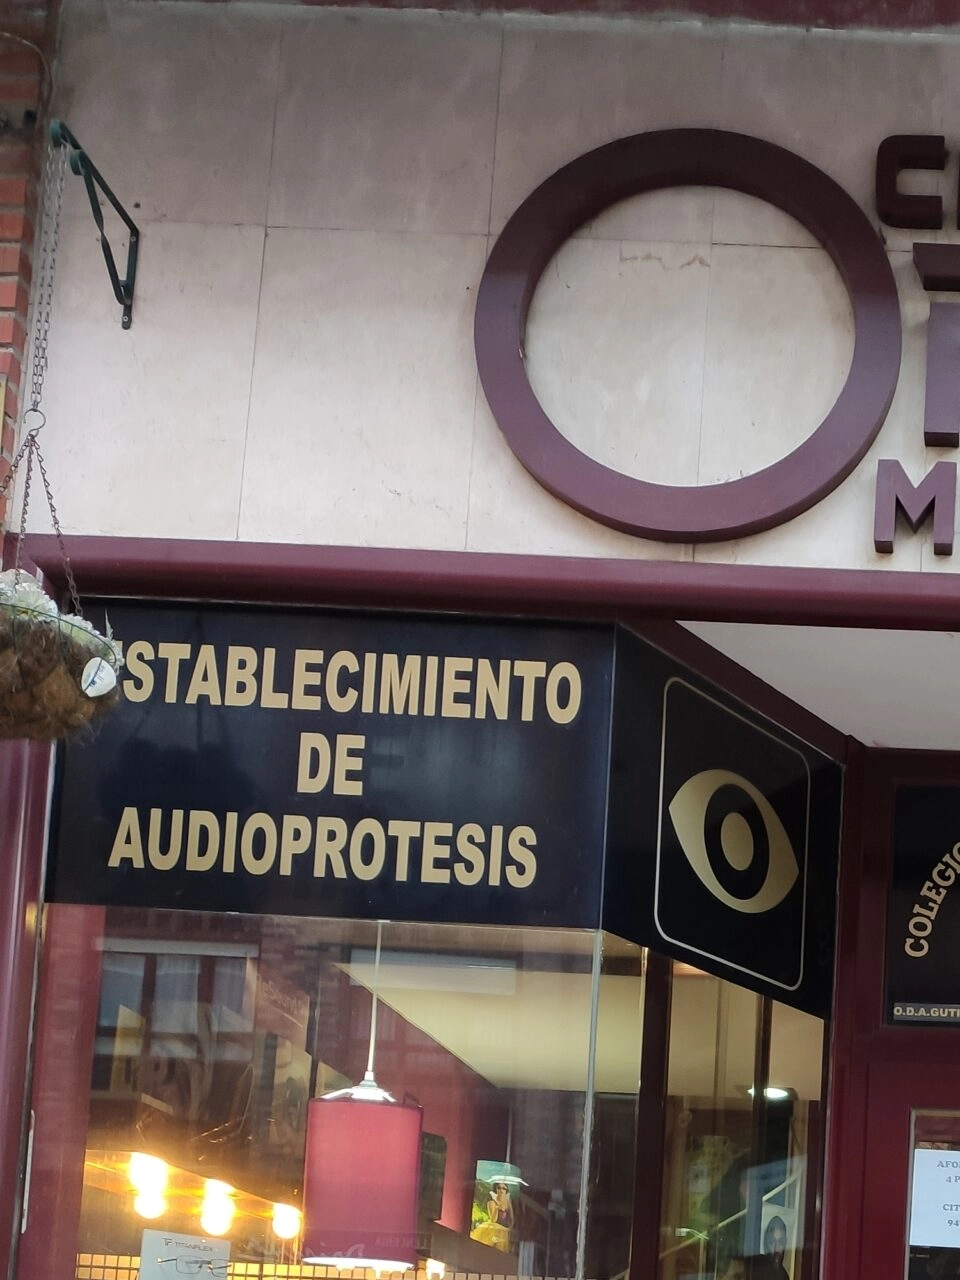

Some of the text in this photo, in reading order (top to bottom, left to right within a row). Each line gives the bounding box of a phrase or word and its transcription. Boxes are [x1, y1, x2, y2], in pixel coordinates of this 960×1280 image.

[112, 641, 582, 725] STABLECIMIENTO
[297, 732, 366, 795] DE
[108, 807, 538, 888] AUDIOPROTESIS
[945, 1175, 952, 1183] 4
